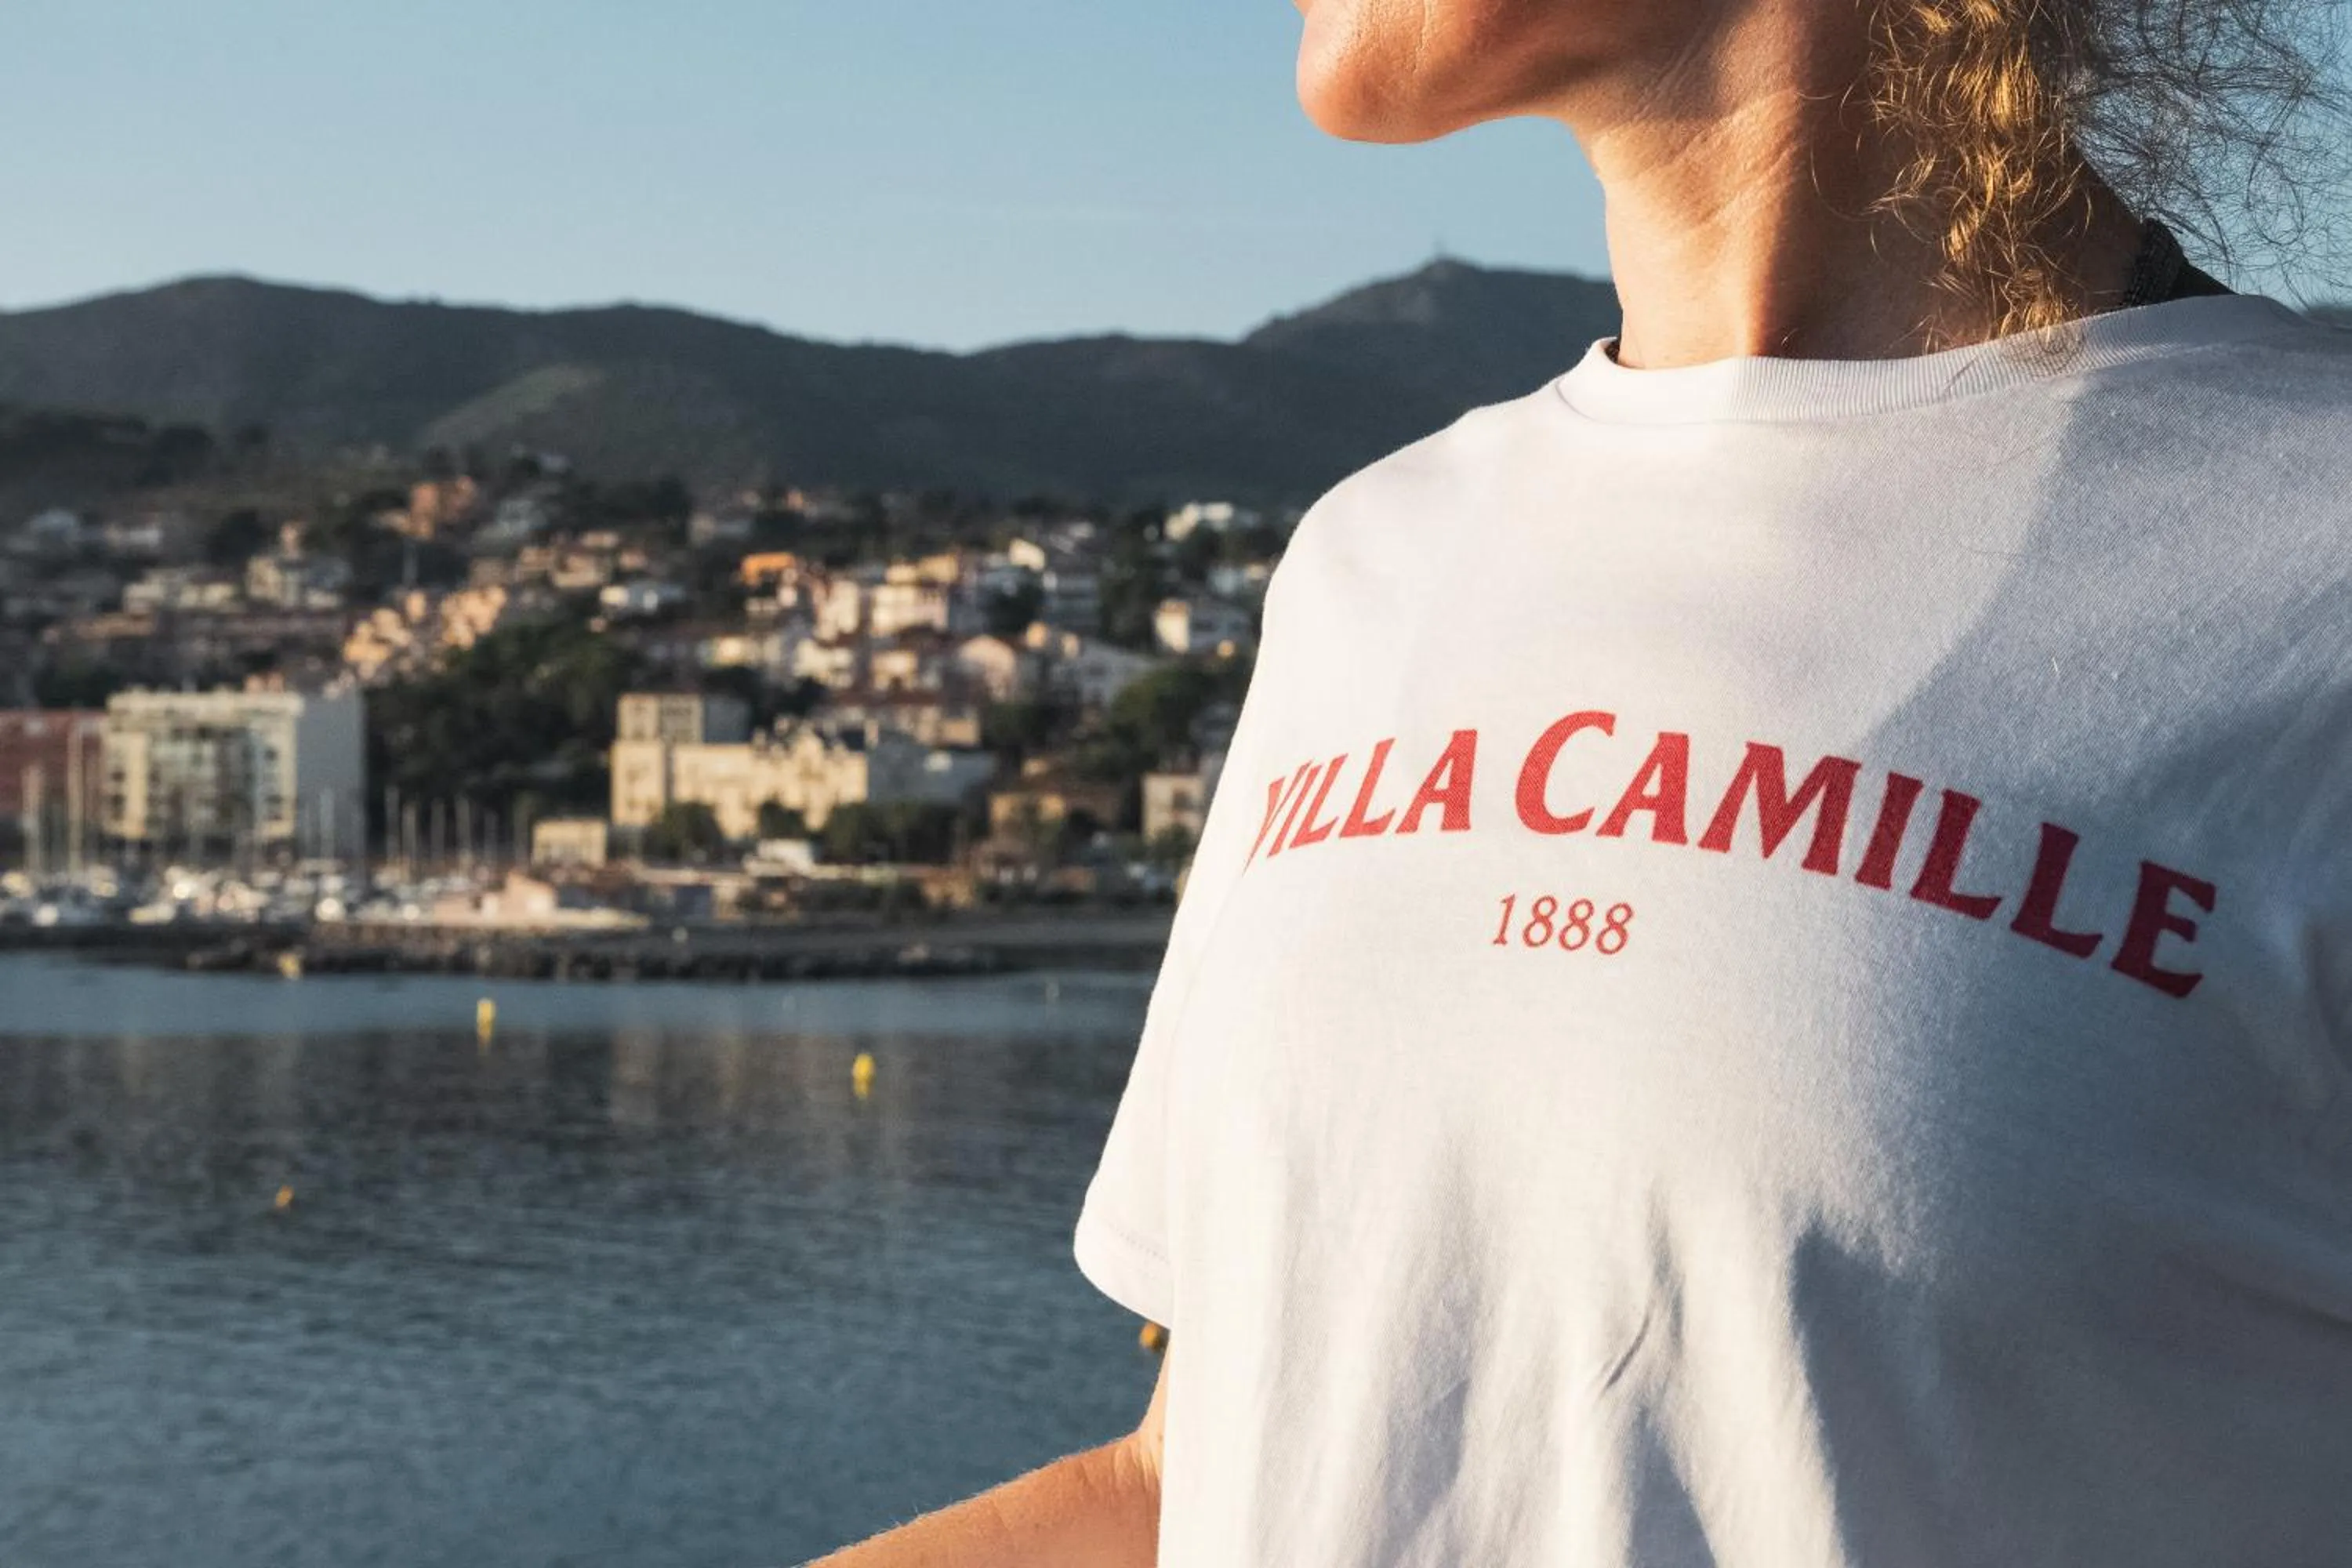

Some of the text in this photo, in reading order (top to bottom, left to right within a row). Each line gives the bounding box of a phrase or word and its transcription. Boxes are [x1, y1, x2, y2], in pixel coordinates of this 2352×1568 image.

[1242, 710, 2216, 999] VILLA CAMILLE
[1492, 893, 1635, 955] 1888
